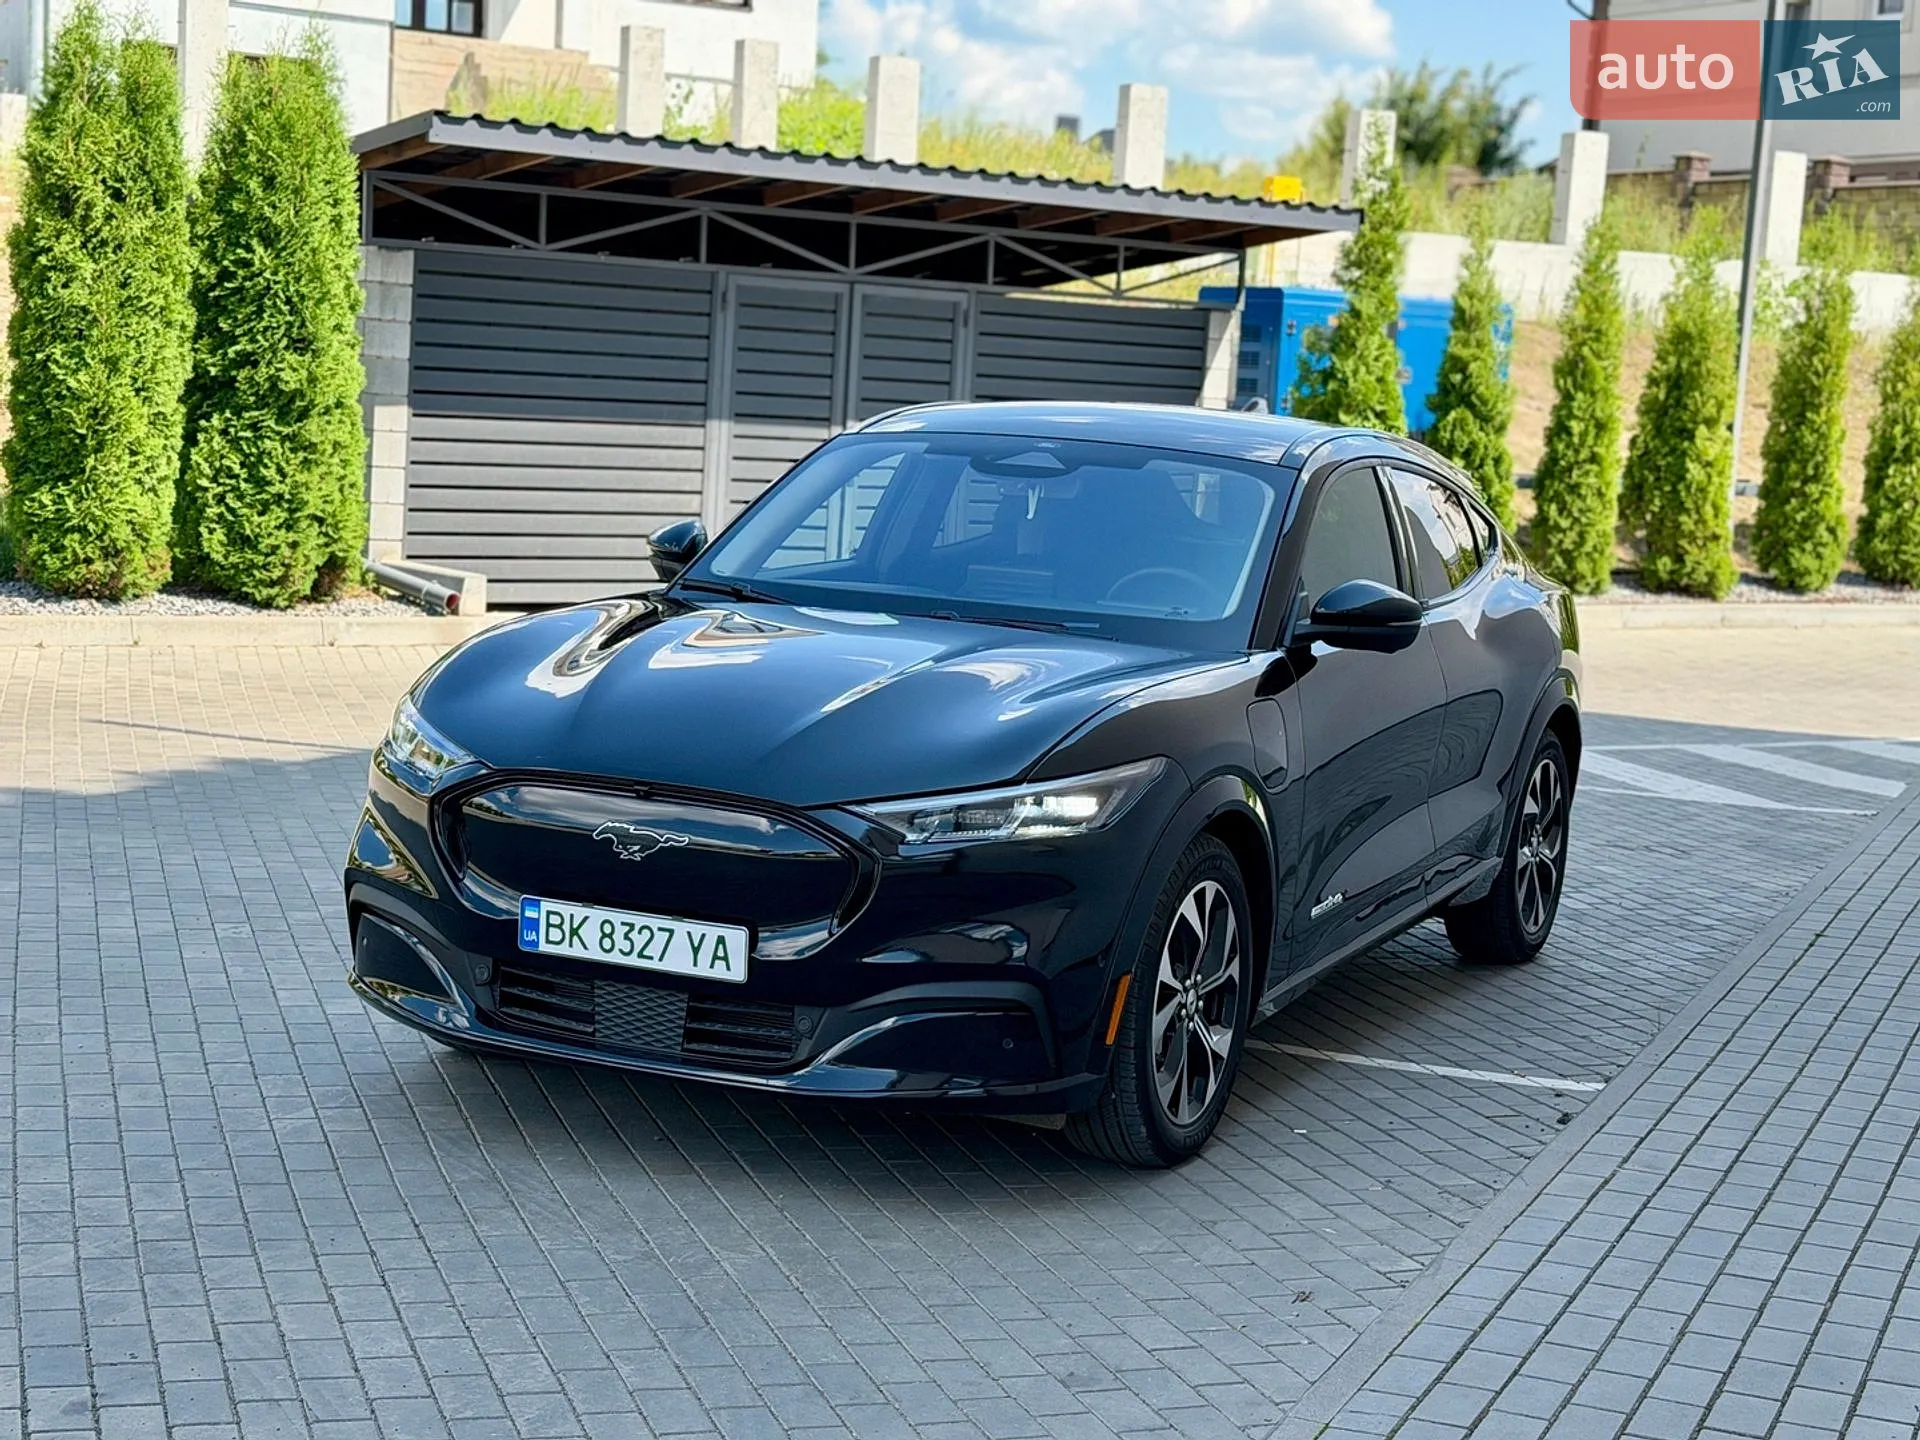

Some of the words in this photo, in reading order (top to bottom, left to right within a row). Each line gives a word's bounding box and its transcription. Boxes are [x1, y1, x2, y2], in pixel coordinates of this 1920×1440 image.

[523, 929, 538, 943] UA
[544, 909, 590, 951] BK
[598, 918, 675, 963] 8327
[686, 930, 732, 972] YA
